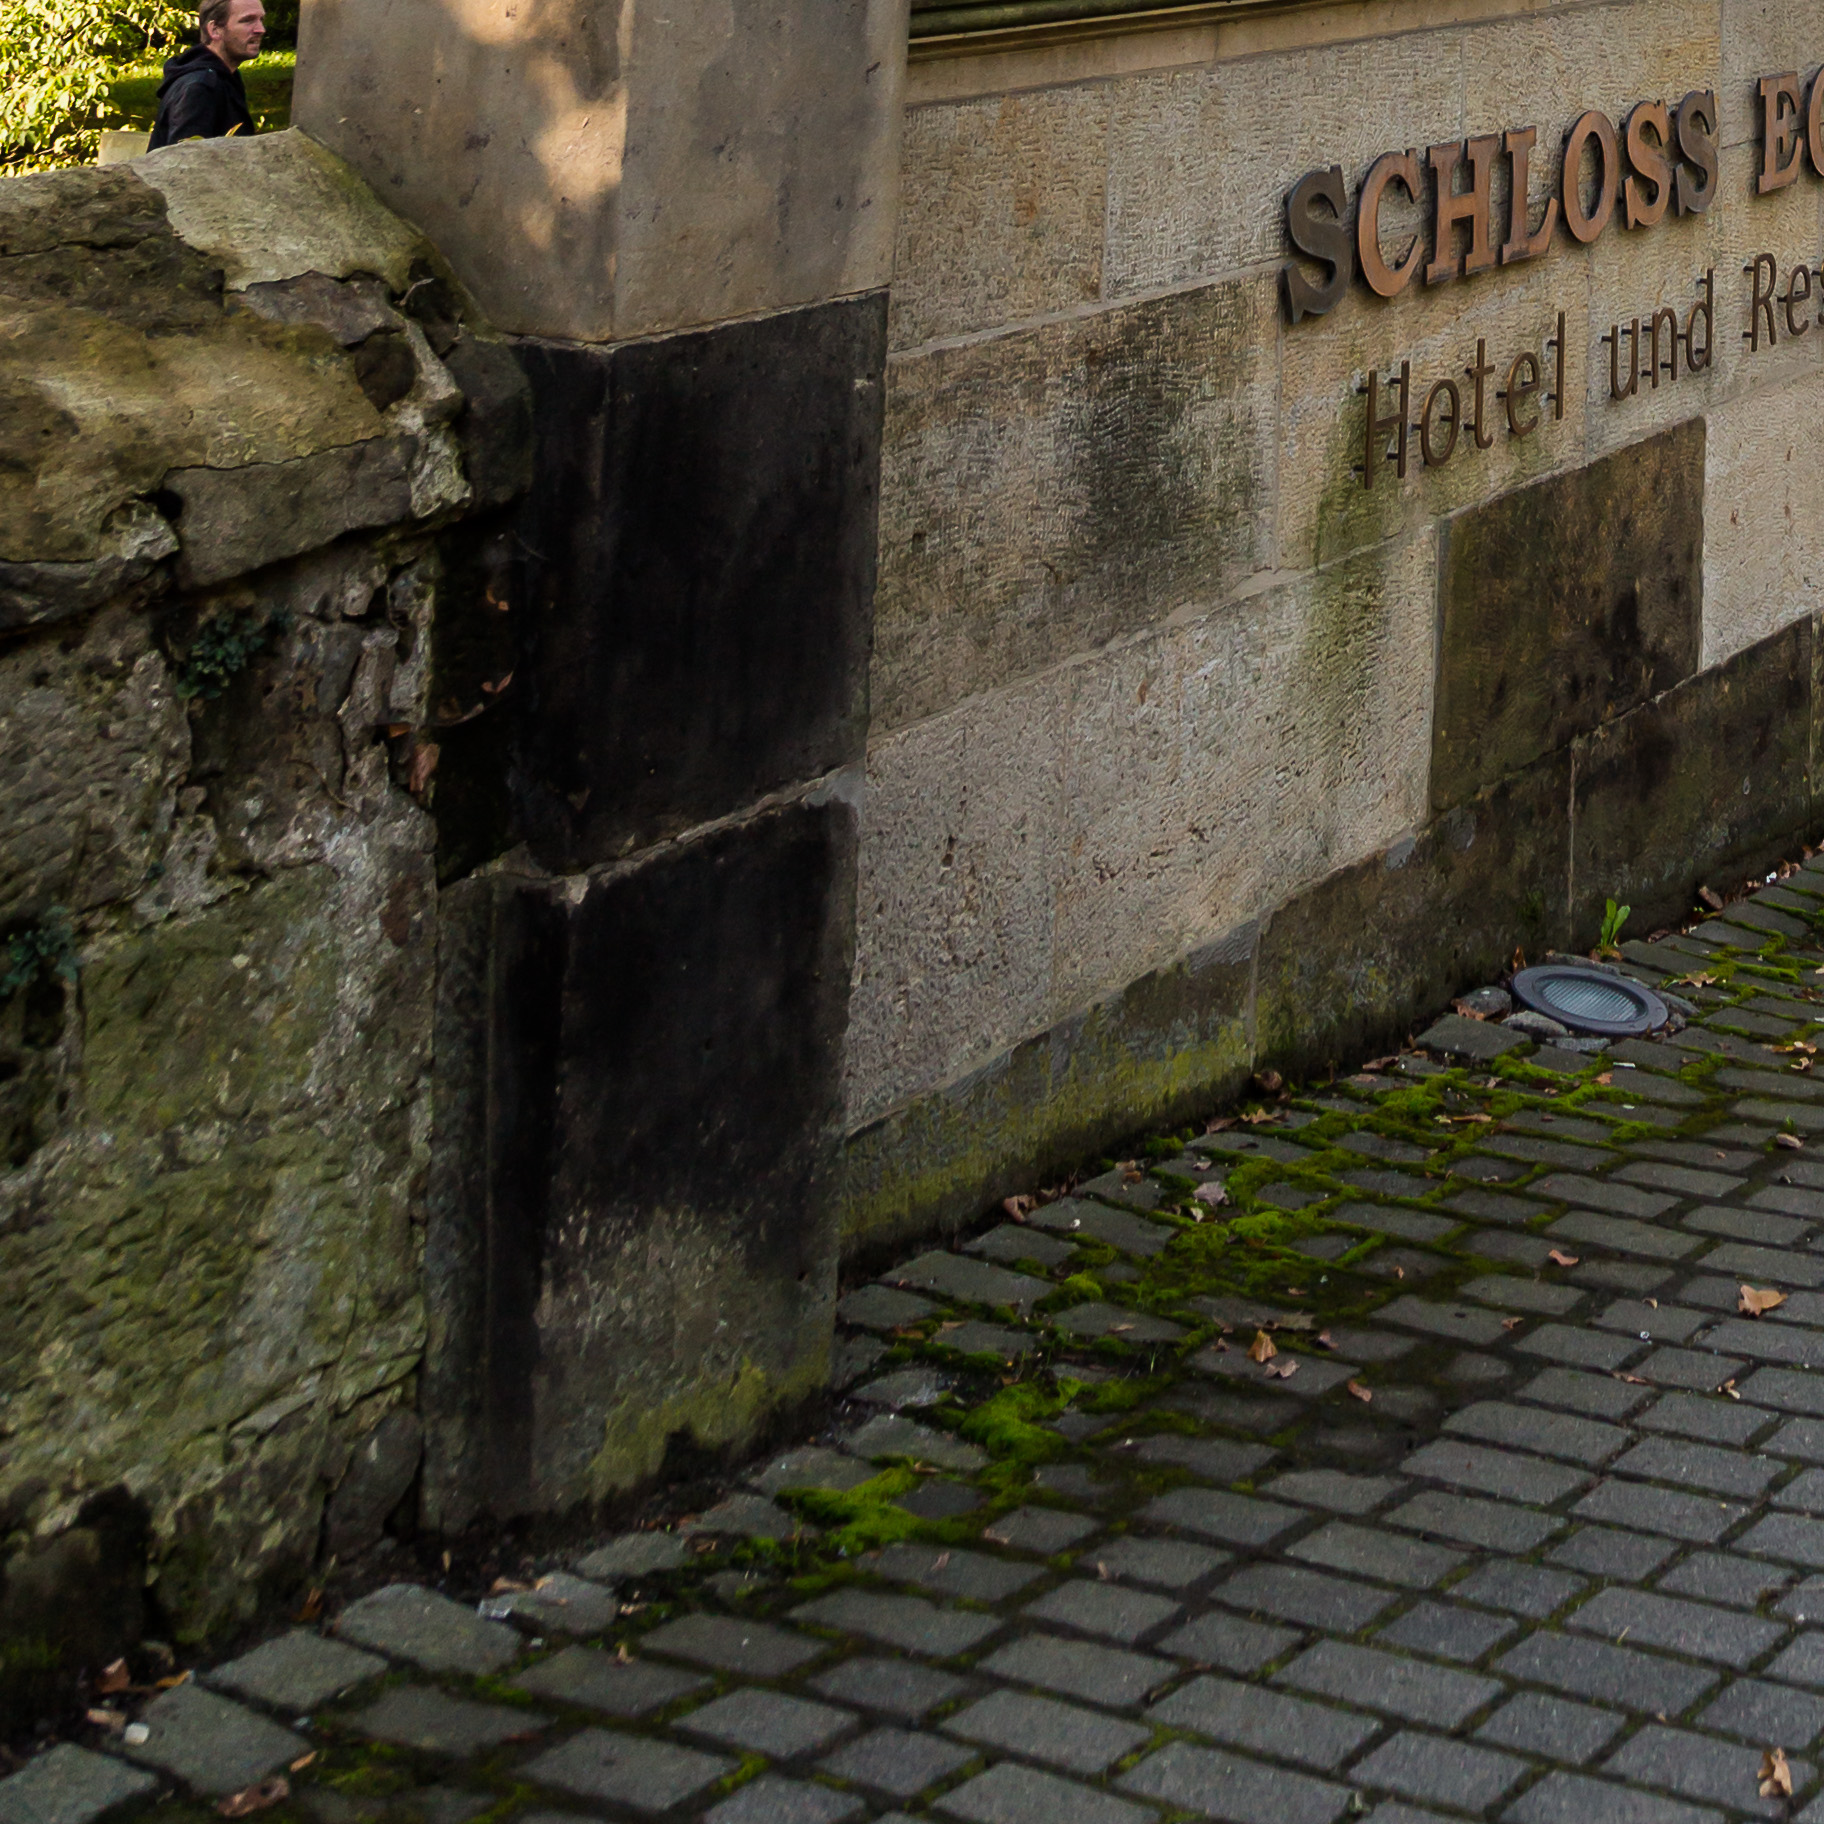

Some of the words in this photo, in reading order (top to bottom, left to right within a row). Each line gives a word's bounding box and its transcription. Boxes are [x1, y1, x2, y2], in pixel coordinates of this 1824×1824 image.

[1281, 89, 1720, 324] SCHLOSS
[1360, 310, 1567, 491] Hotel
[1606, 266, 1716, 402] und
